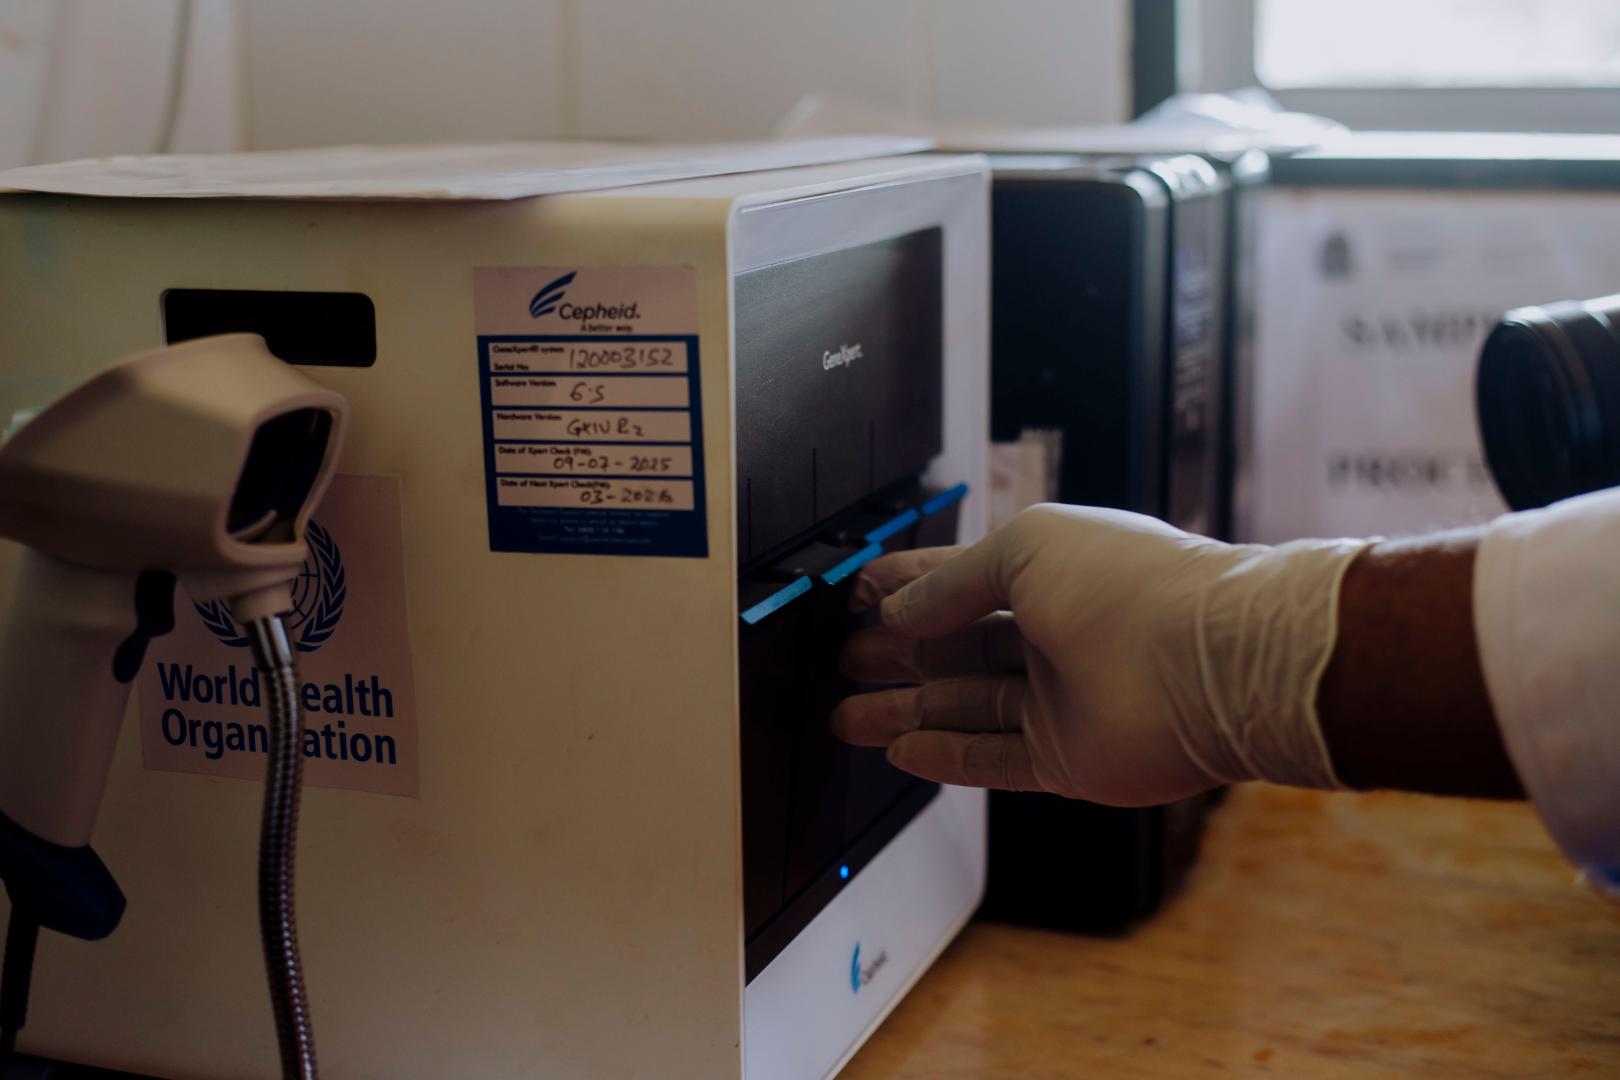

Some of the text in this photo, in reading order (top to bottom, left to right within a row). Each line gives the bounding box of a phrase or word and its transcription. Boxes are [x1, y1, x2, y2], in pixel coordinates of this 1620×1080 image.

[588, 324, 613, 333] better
[569, 347, 673, 369] 120003152
[494, 362, 515, 371] Serial
[494, 379, 527, 388] Software
[496, 412, 533, 421] Hardware
[498, 446, 517, 455] Date
[518, 446, 526, 454] of
[528, 447, 548, 456] Xpert
[550, 447, 571, 455] Check
[500, 479, 519, 488] Date
[520, 479, 528, 488] of
[529, 480, 548, 488] Next
[549, 480, 570, 490] Xpert
[157, 662, 394, 718] World ealth
[161, 708, 397, 765] Organation
